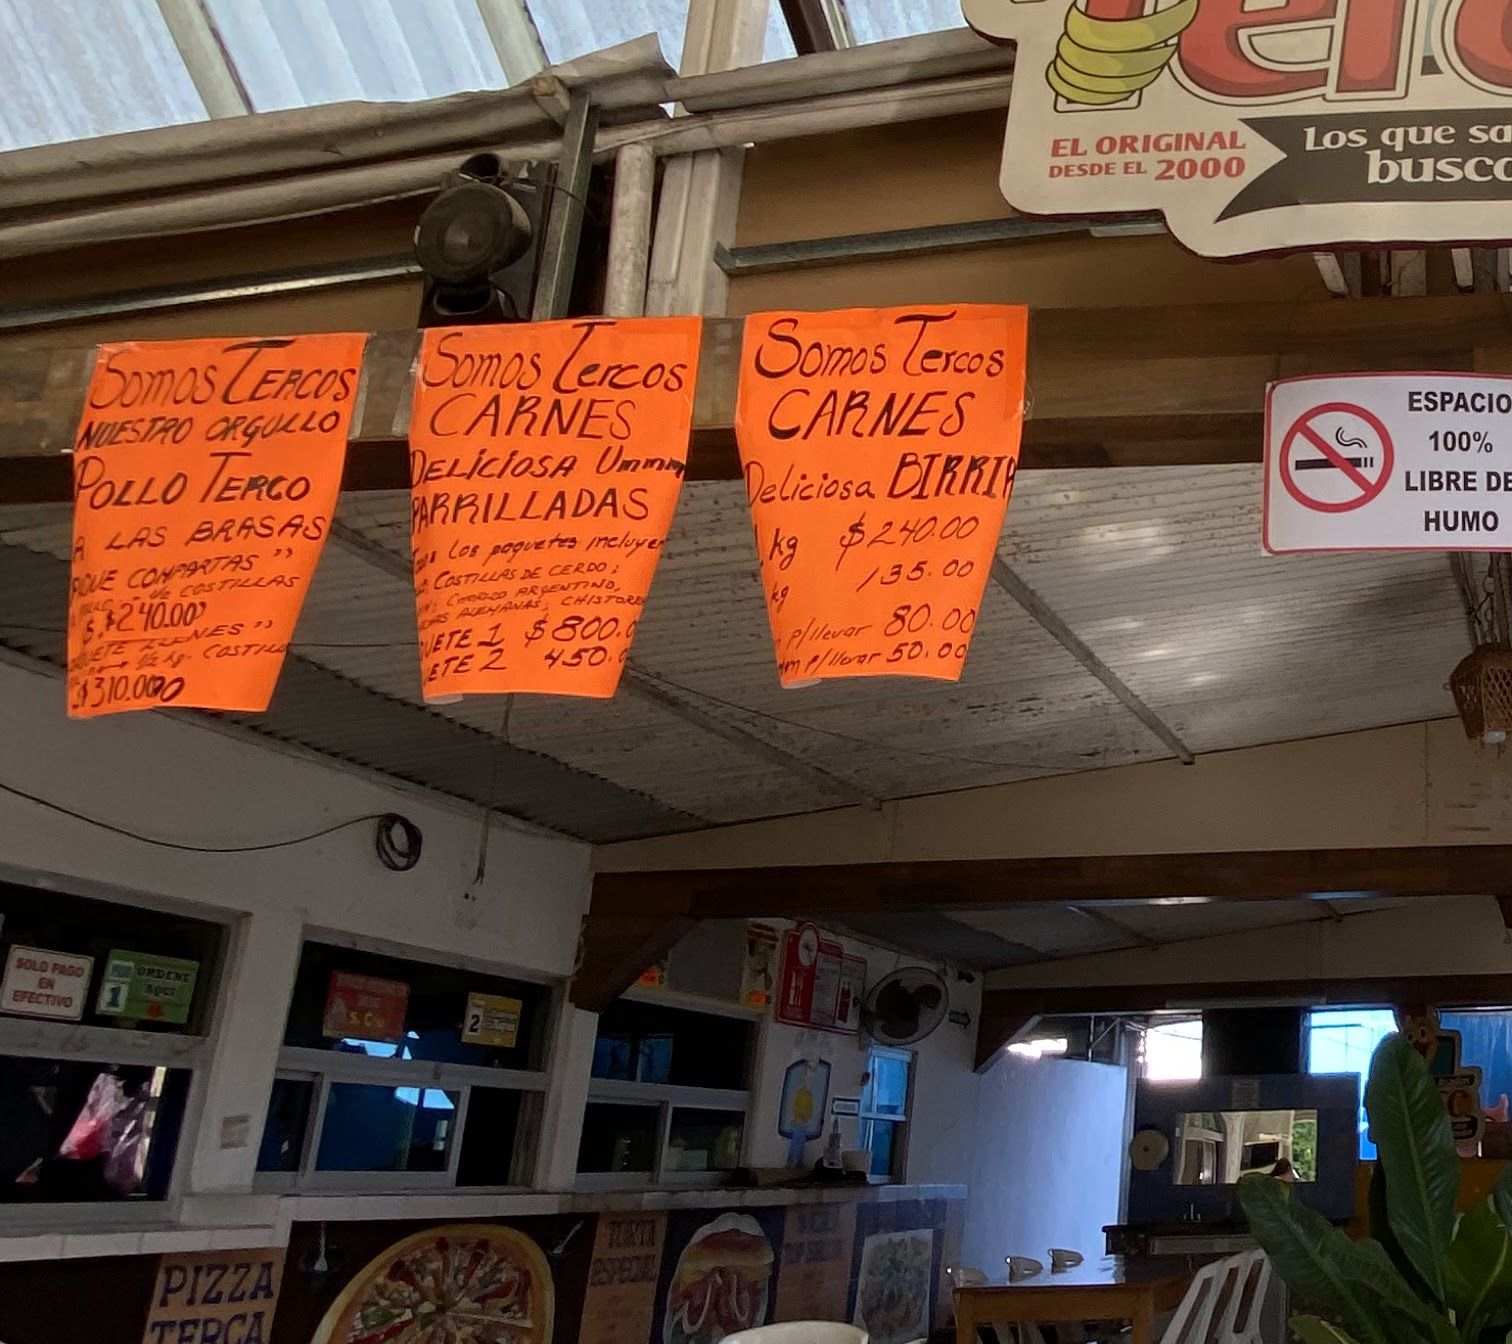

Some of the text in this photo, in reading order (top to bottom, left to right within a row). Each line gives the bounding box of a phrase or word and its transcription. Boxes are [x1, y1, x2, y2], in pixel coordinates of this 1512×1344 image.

[1052, 131, 1246, 156] EL ORIGINAL
[1304, 127, 1367, 152] Los
[1381, 124, 1455, 153] que
[1049, 156, 1246, 181] DESDE EL 2000
[552, 322, 687, 394] Tercos
[755, 311, 1004, 378] Somos Tercos
[222, 339, 357, 405] TERCOS
[430, 394, 636, 440] CARNES
[769, 389, 975, 440] CARNES
[1408, 392, 1512, 414] ESPACIO
[78, 411, 339, 450] NUESTRO ORGULLO
[1429, 430, 1493, 453] 100%
[76, 452, 310, 509] POLLO TERCO
[410, 449, 578, 489] DELICIOSA
[745, 461, 875, 505] Deliciosa
[1405, 471, 1476, 492] LIBRE
[411, 488, 649, 535] PARRILLADAS
[1424, 511, 1498, 532] HUMO
[106, 514, 325, 551] LAS BRASAS
[521, 568, 542, 580] DE
[16, 957, 84, 978] SOLO PAGO
[38, 978, 54, 990] EN
[13, 990, 73, 1007] EFECTIVO
[160, 1262, 273, 1307] PIZZA
